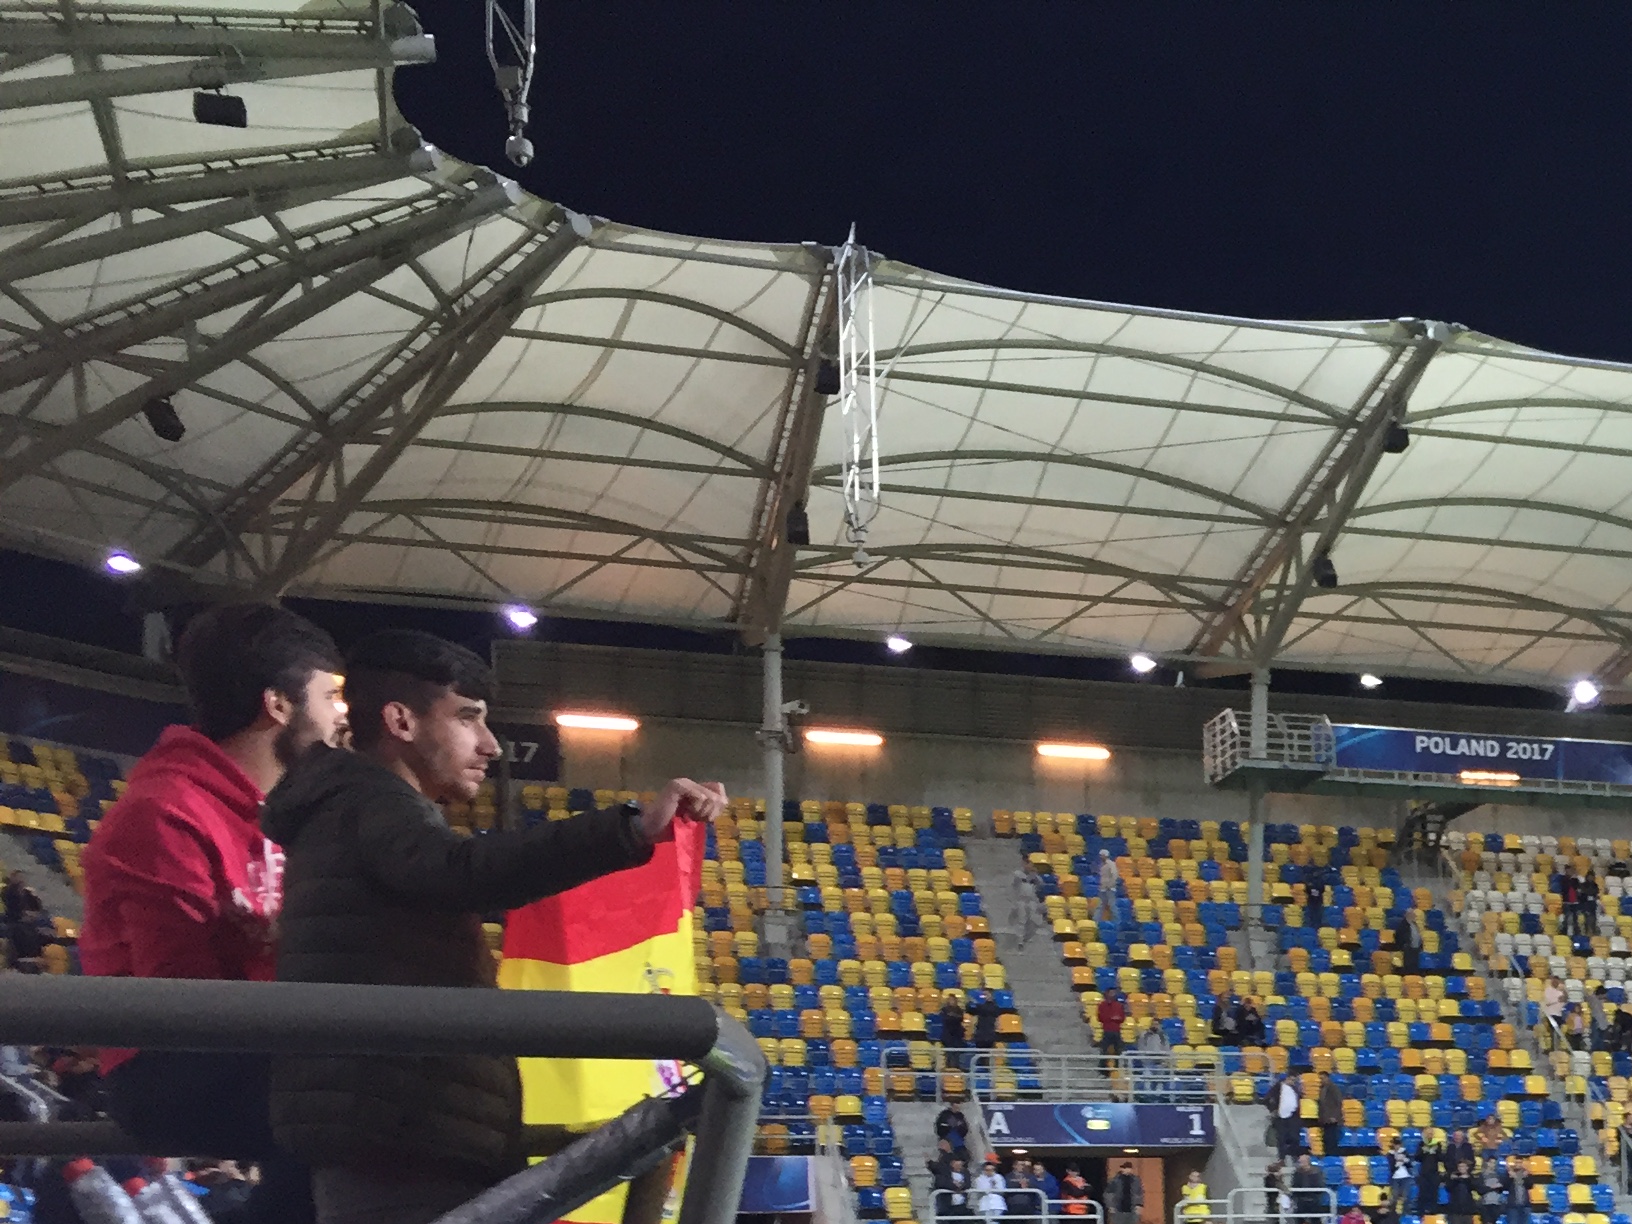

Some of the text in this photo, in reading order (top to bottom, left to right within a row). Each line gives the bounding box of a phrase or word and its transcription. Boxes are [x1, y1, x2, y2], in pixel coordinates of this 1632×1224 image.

[490, 741, 539, 762] 17
[1415, 735, 1555, 760] POLAND 2017
[988, 1111, 1011, 1135] A
[1188, 1113, 1206, 1136] 1
